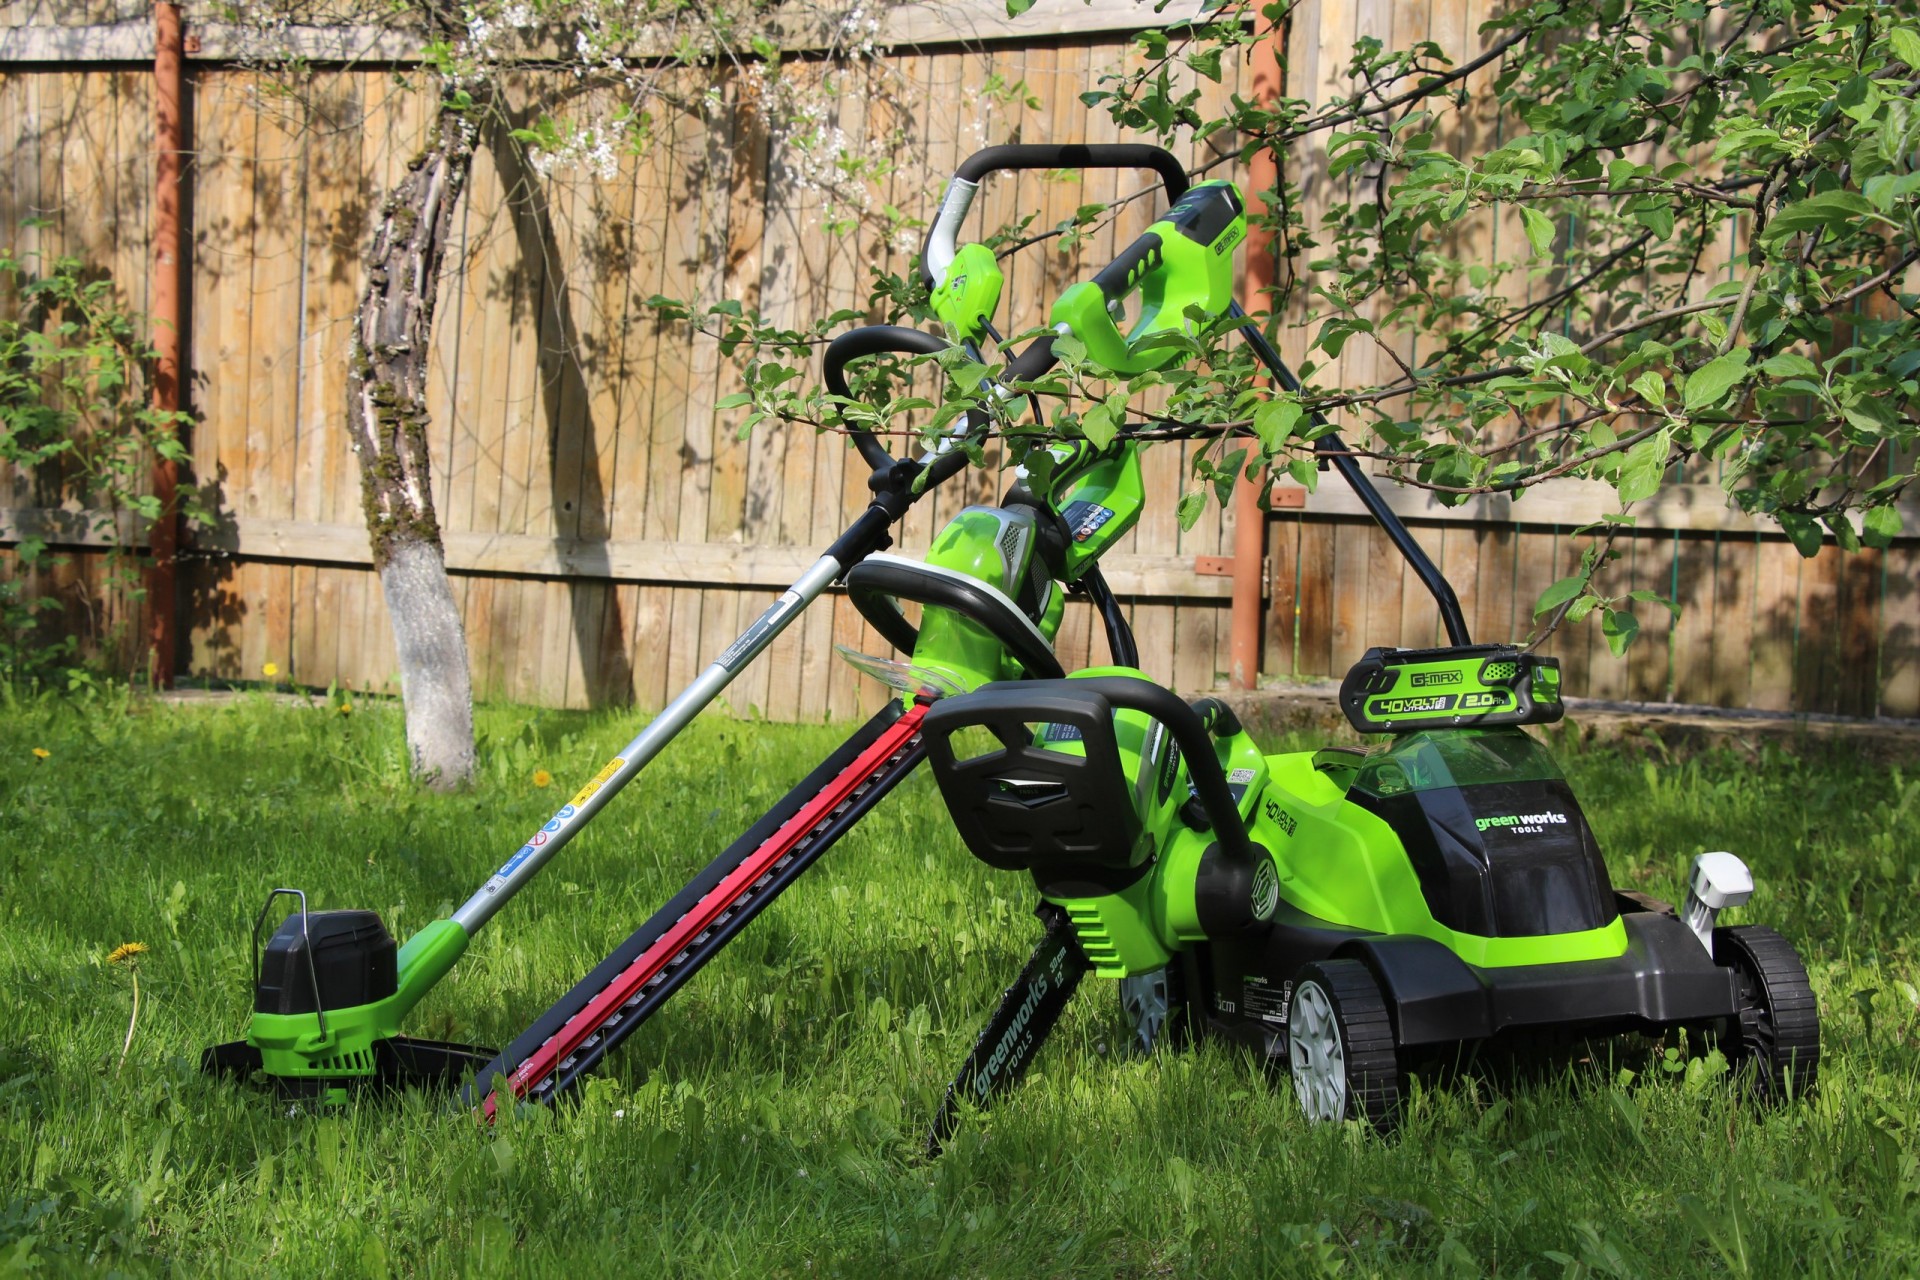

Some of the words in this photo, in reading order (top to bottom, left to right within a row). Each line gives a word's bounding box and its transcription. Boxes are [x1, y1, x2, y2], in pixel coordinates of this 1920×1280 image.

[1510, 825, 1544, 834] TOOLS
[975, 973, 1048, 1102] greenworks
[1005, 1029, 1034, 1076] TOOLS
